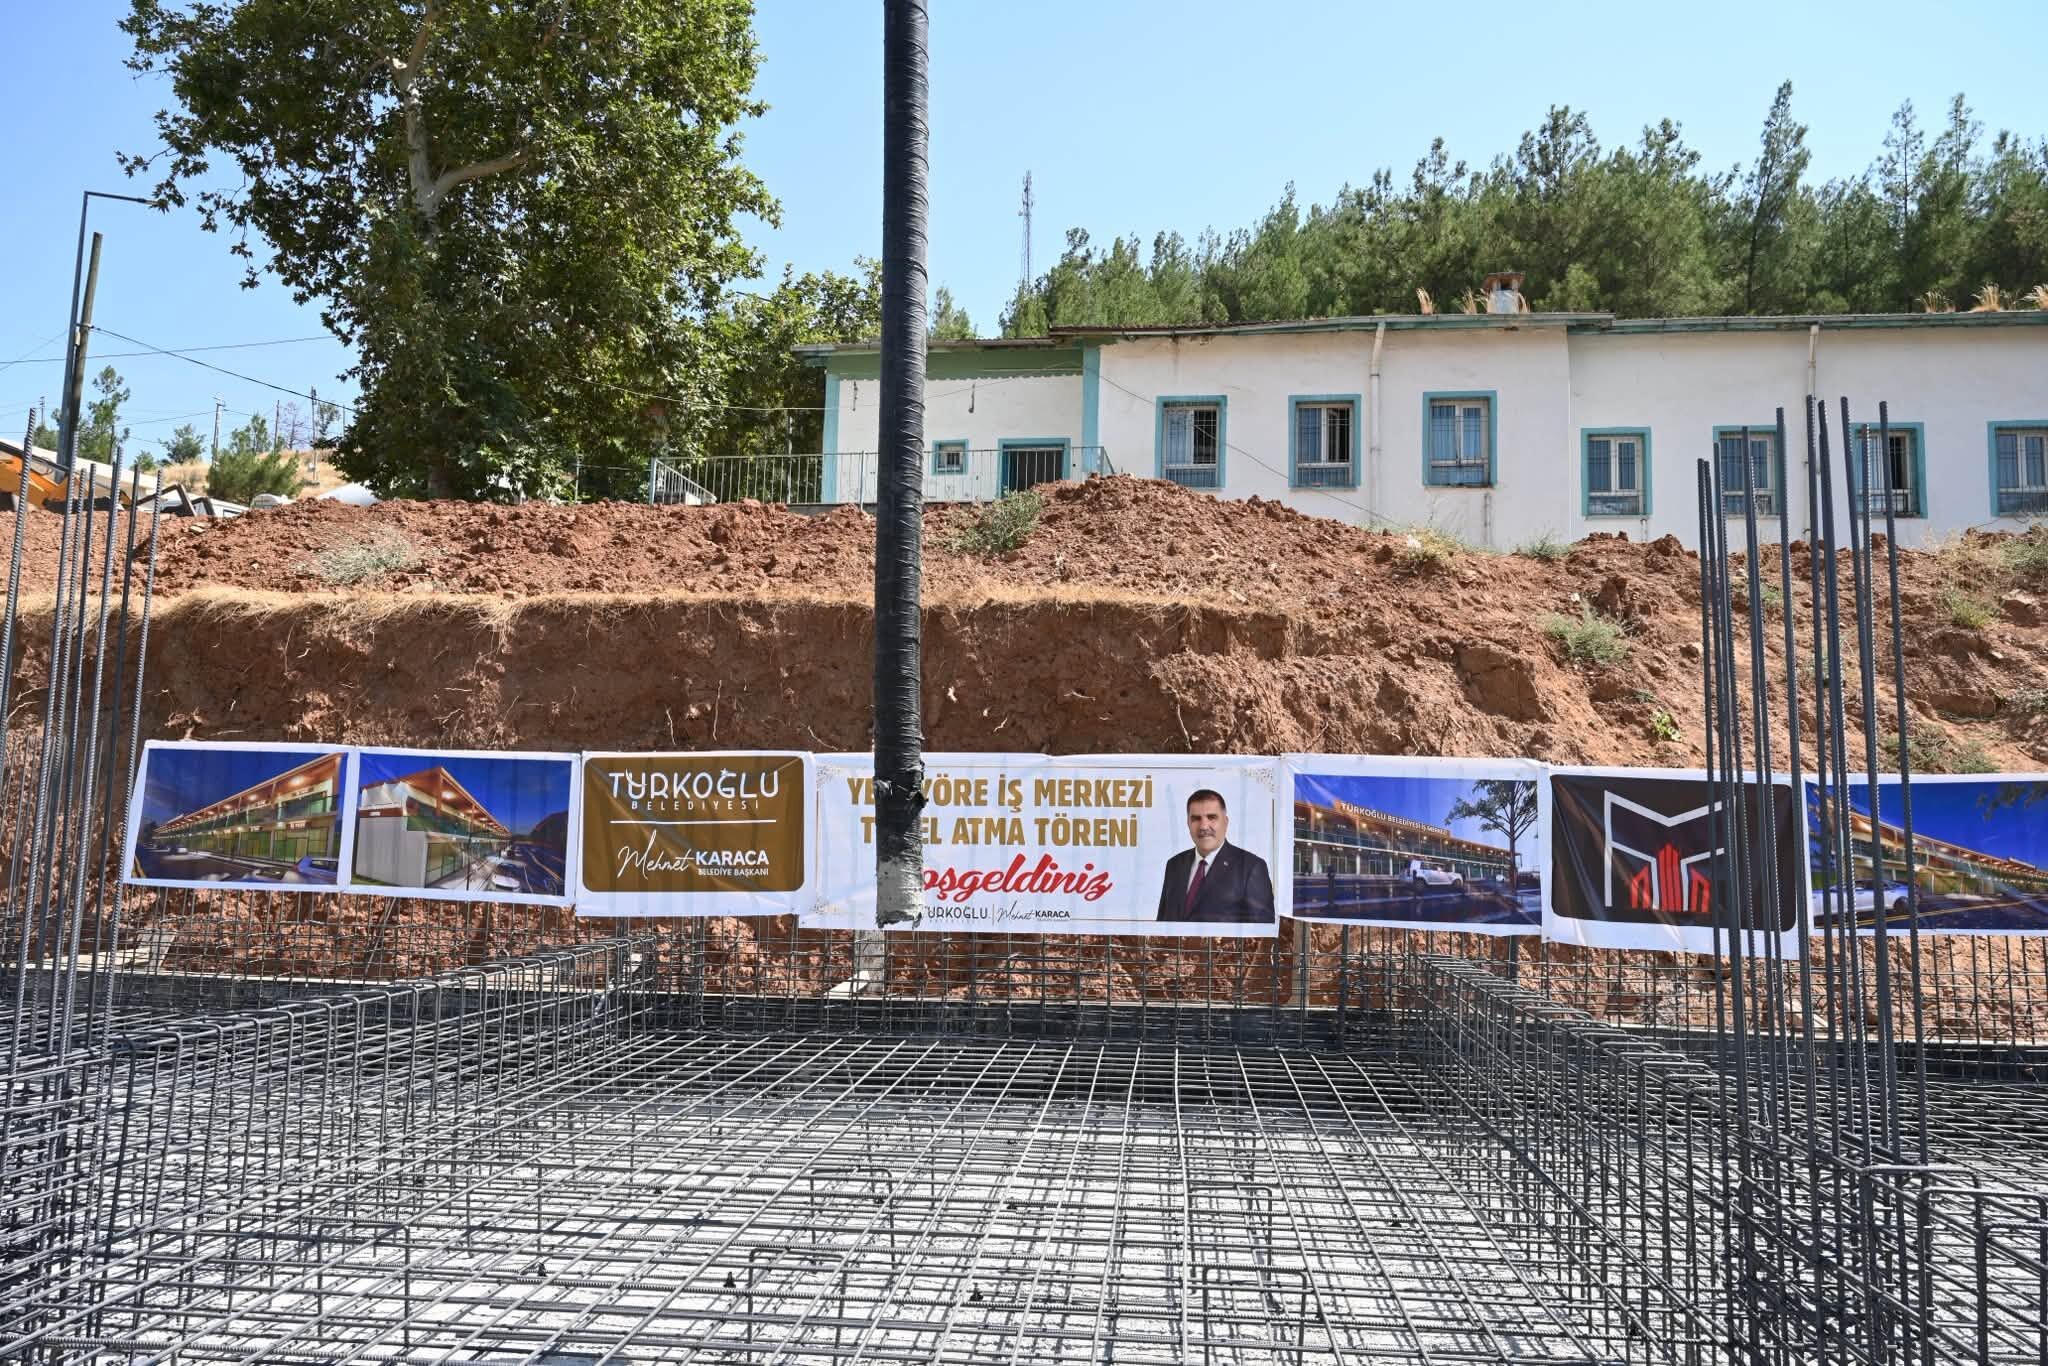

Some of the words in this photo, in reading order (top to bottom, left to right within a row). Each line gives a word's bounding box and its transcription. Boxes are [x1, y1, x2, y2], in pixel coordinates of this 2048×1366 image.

[609, 768, 779, 799] TÜRKOĞLU
[997, 773, 1024, 813] İŞ
[1034, 774, 1154, 808] MERKEZİ
[1341, 802, 1386, 820] TÜRKOĞLU
[860, 816, 942, 845] TEL
[951, 817, 1026, 846] ATMA
[1034, 812, 1138, 847] TÖRENİ
[617, 828, 695, 880] Mehmet
[695, 850, 770, 866] KARACA
[698, 867, 732, 876] BELEDİYE
[923, 853, 1113, 903] oşgeldiniz
[926, 905, 988, 920] ÜRKOĞLU
[1035, 910, 1071, 919] KARACA
